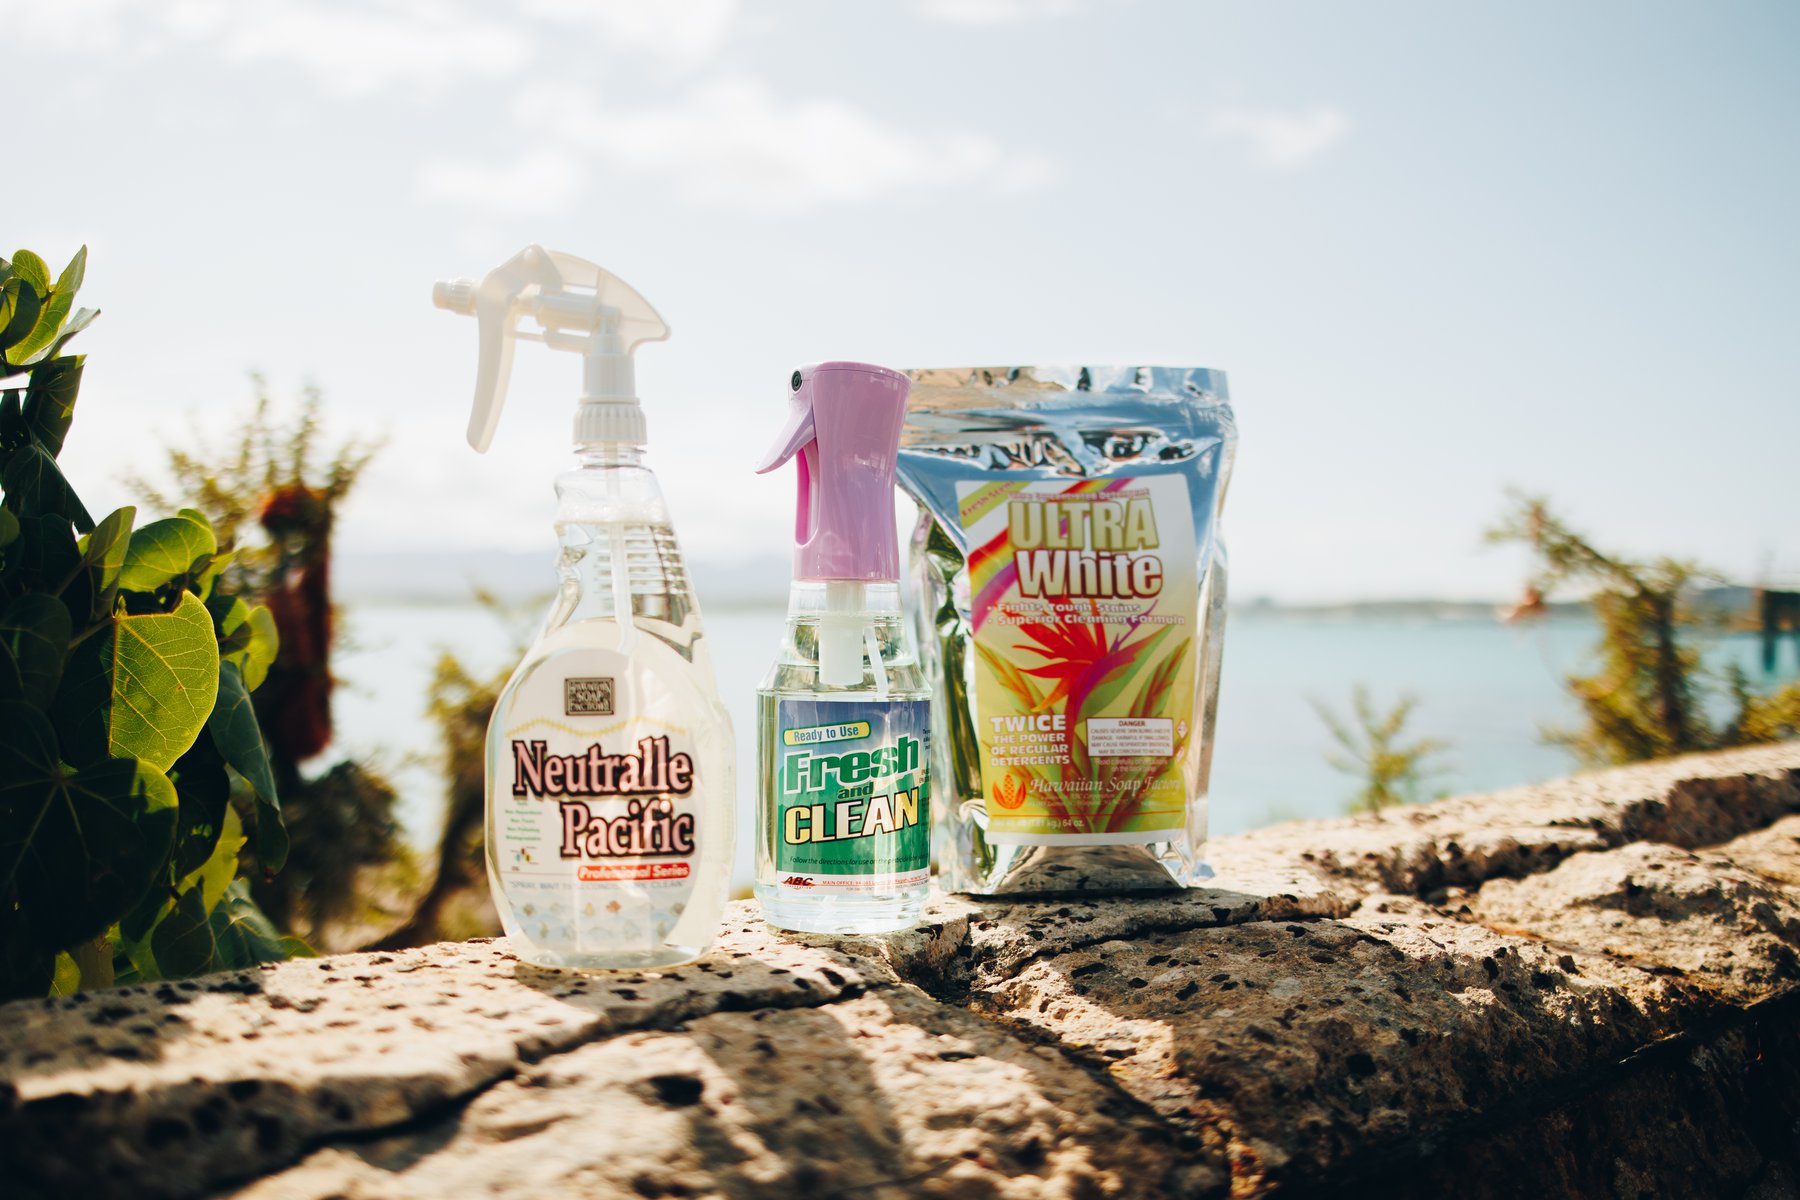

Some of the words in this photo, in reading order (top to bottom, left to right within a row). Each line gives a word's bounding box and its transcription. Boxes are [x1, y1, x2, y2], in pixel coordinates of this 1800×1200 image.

[1008, 497, 1160, 550] ULTRA
[1013, 548, 1164, 599] White
[997, 602, 1044, 613] Fights
[1048, 602, 1092, 613] Tough
[1096, 602, 1141, 613] Stains
[998, 615, 1061, 626] Superior
[1064, 614, 1127, 625] Cleaning
[1130, 614, 1185, 625] Formula
[990, 714, 1067, 733] TWICE
[794, 730, 822, 743] Ready
[826, 729, 836, 739] to
[840, 726, 859, 737] Use
[993, 735, 1016, 744] THE
[1020, 732, 1066, 743] POWER
[991, 746, 1006, 755] OF
[1010, 744, 1069, 754] REGULAR
[512, 735, 694, 800] Neutralle
[784, 733, 920, 795] Fresh
[990, 755, 1071, 767] DETERGENTS
[838, 781, 875, 799] and
[1029, 778, 1103, 794] Hawaiian
[1106, 776, 1142, 797] Soap
[1143, 777, 1182, 794] Factory
[784, 786, 919, 845] CLEAN
[1062, 819, 1072, 827] 64
[560, 797, 695, 860] Pacific
[790, 856, 807, 864] Follow
[818, 857, 848, 865] directions
[848, 857, 858, 865] for
[652, 864, 689, 878] Series
[783, 876, 814, 886] ABC
